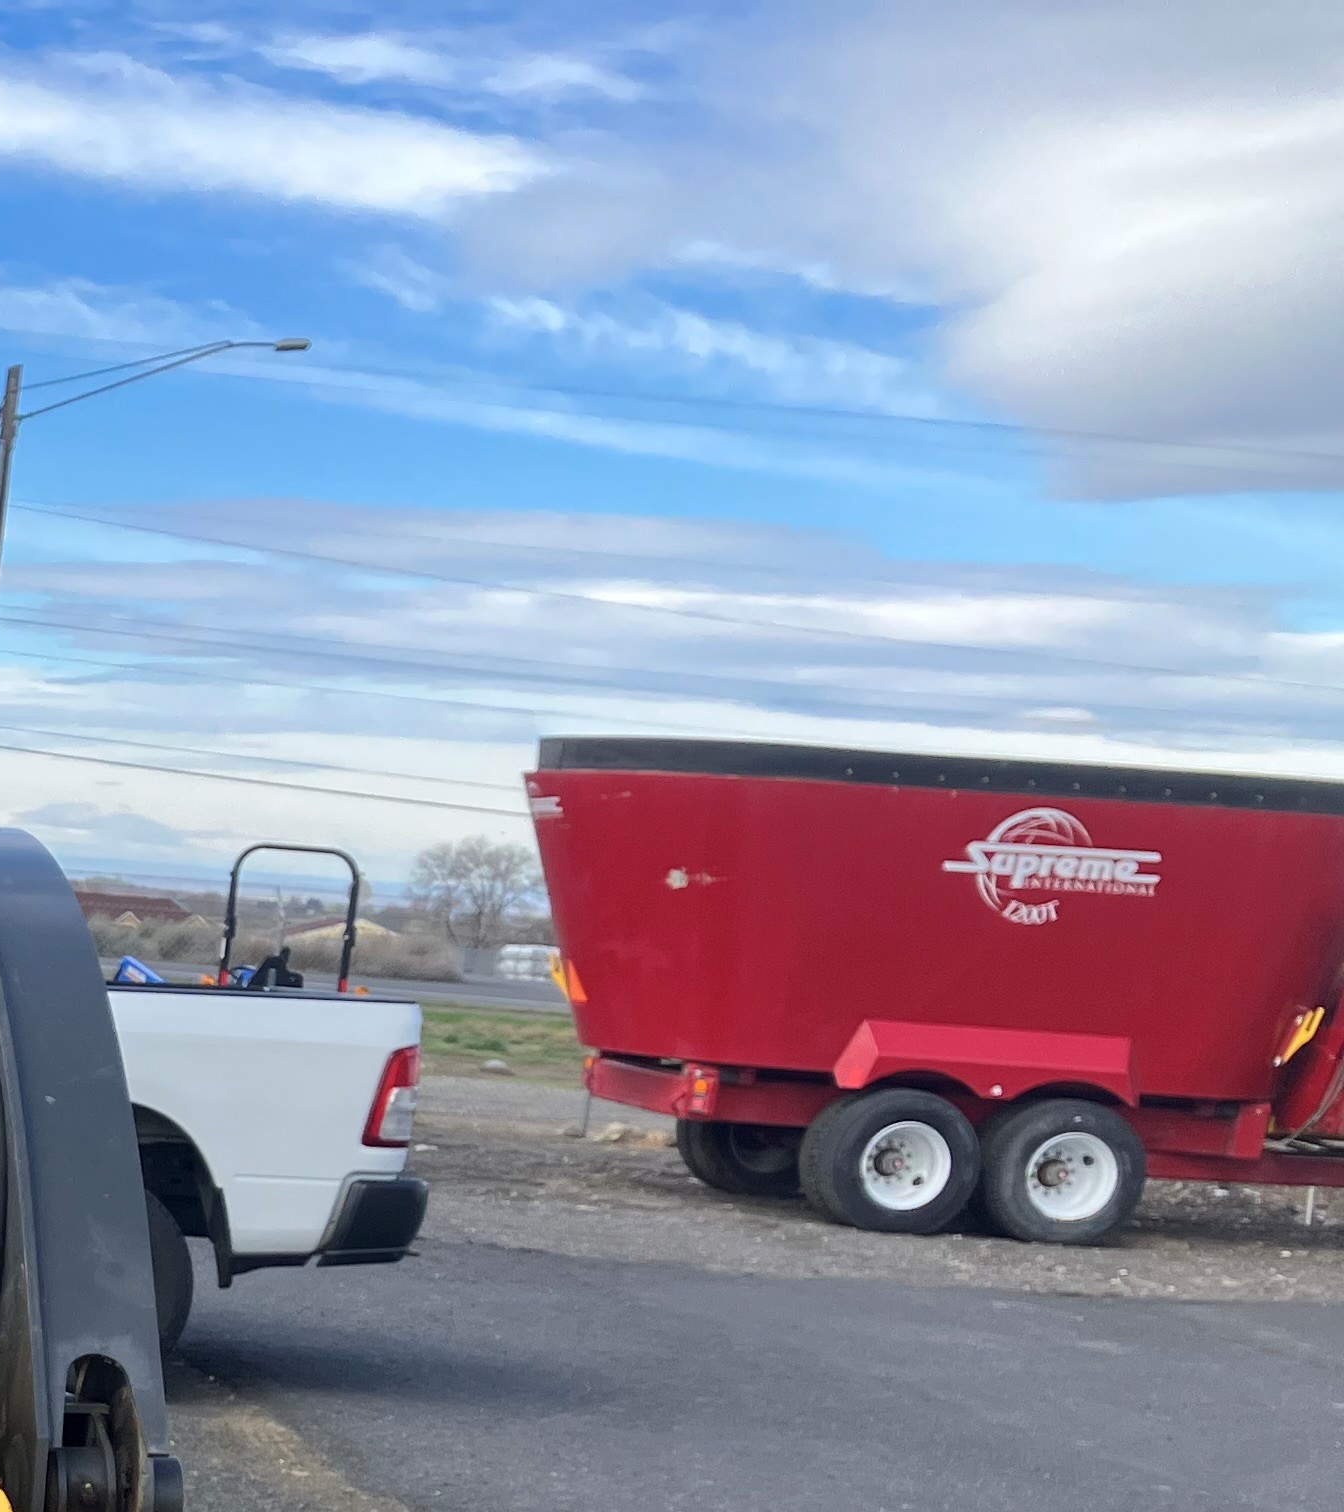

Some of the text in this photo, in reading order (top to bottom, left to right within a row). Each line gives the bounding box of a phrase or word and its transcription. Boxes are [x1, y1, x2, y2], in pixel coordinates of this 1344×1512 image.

[942, 841, 1162, 889] Supreme
[1024, 878, 1156, 897] INTERNATIONAL
[1002, 899, 1061, 926] 1200T
